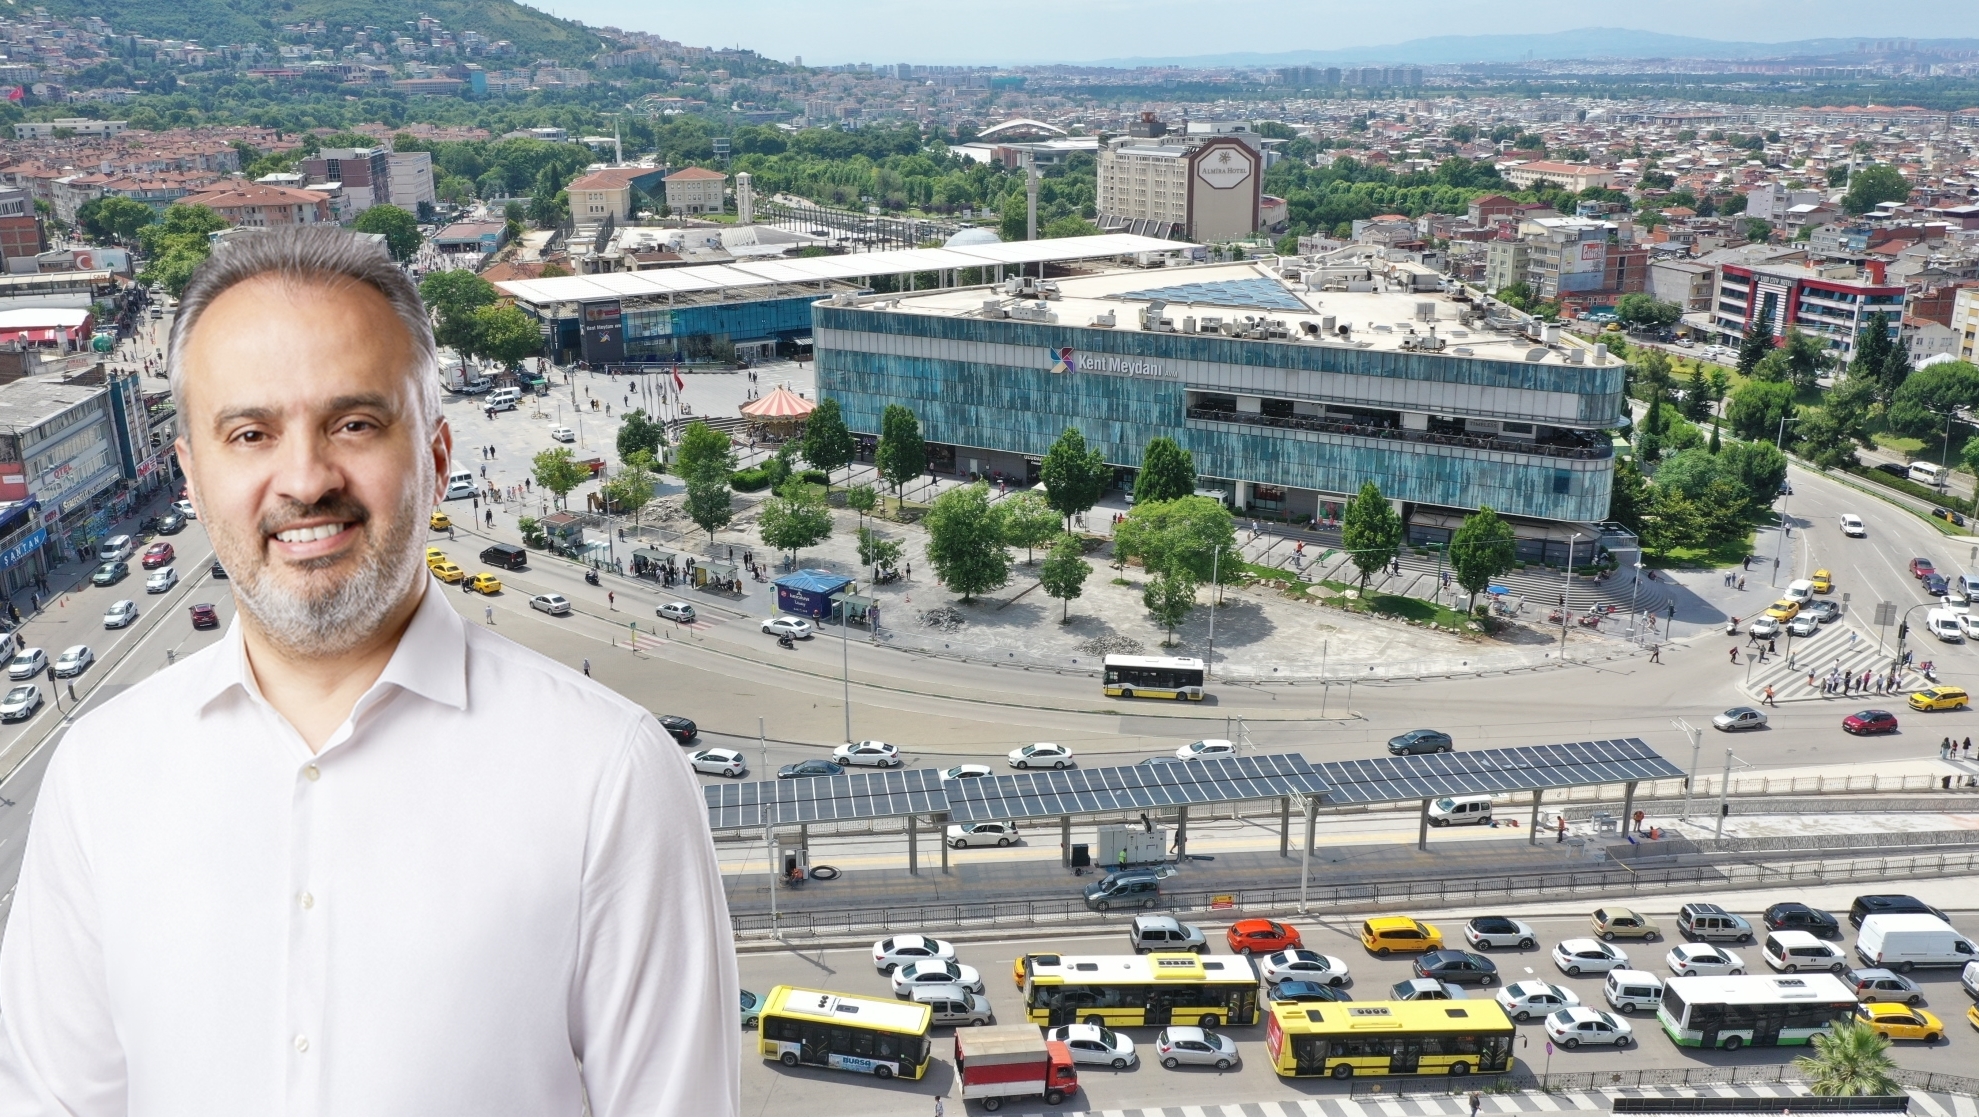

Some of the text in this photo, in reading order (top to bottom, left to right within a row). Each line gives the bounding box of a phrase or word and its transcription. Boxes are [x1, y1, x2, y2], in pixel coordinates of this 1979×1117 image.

[1079, 354, 1178, 378] Kent Meydanı AVM
[53, 463, 72, 479] OTEL
[842, 1056, 872, 1068] BURSA
